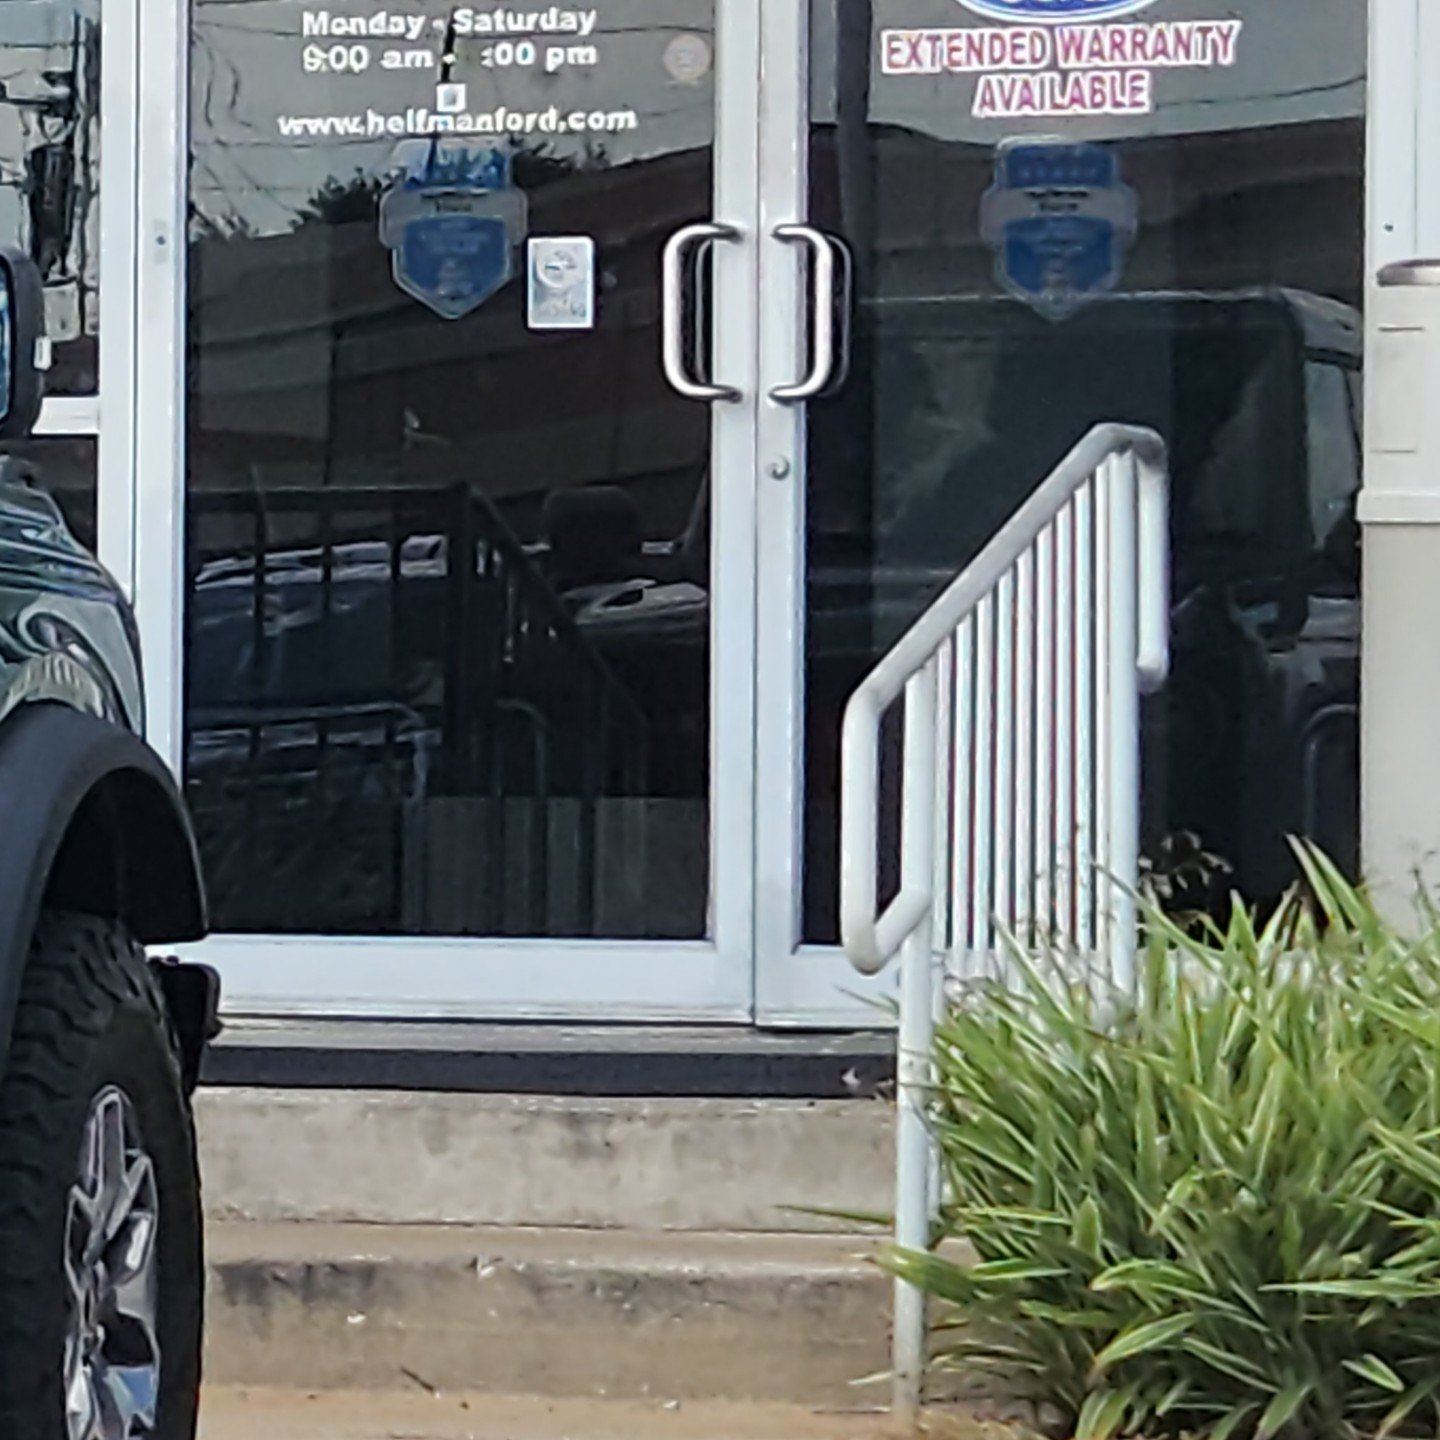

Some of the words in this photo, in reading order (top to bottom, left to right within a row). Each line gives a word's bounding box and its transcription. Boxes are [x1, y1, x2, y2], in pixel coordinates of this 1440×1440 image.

[302, 10, 426, 40] Monday
[452, 7, 598, 36] Saturday
[380, 48, 434, 69] am
[546, 43, 599, 72] pm
[884, 29, 1049, 71] EXTENDED
[1056, 21, 1240, 65] WARRANTY
[976, 73, 1149, 114] AVAILABLE
[278, 106, 638, 137] www.helfmanford.com
